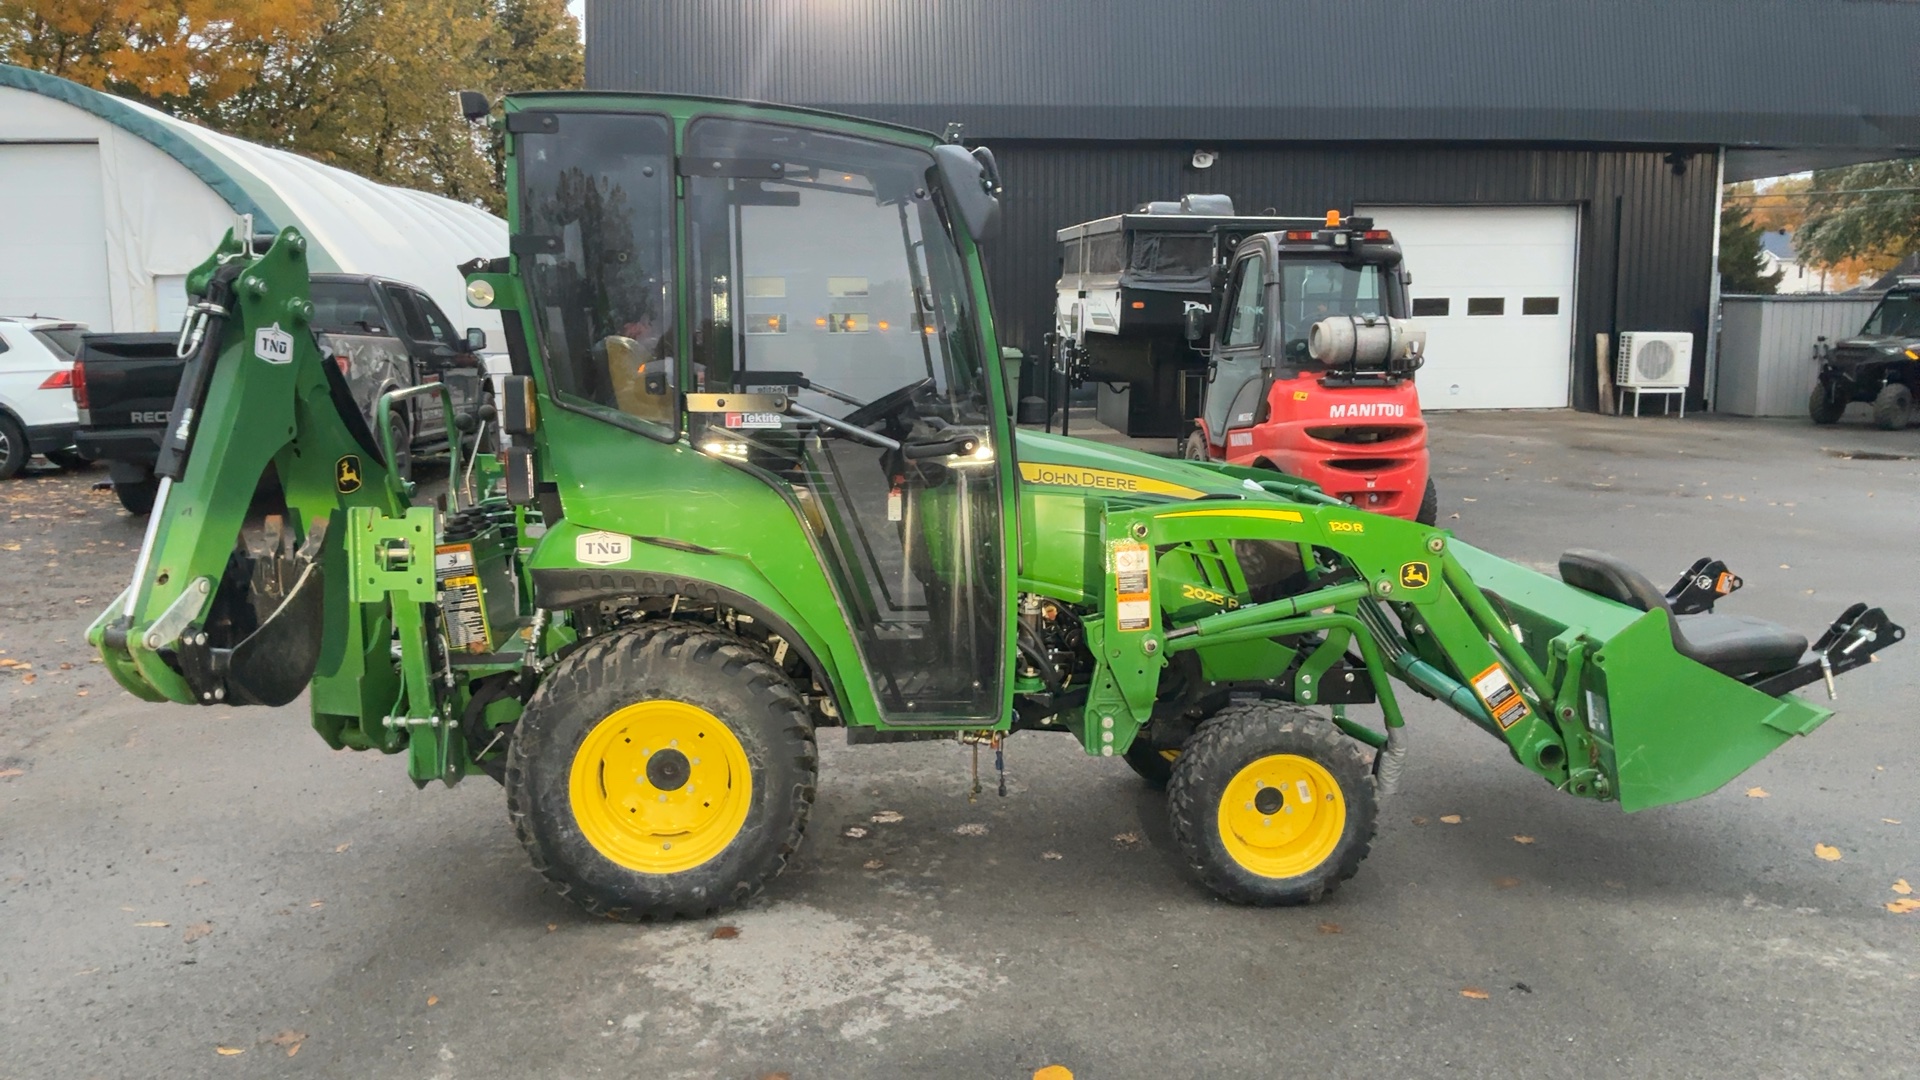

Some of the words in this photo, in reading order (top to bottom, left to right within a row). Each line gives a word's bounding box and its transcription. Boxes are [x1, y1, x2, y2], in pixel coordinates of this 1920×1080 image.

[742, 412, 781, 423] Tektite
[1329, 403, 1404, 418] MANITOU
[1033, 469, 1078, 484] JOHN
[1082, 472, 1138, 491] DEERE
